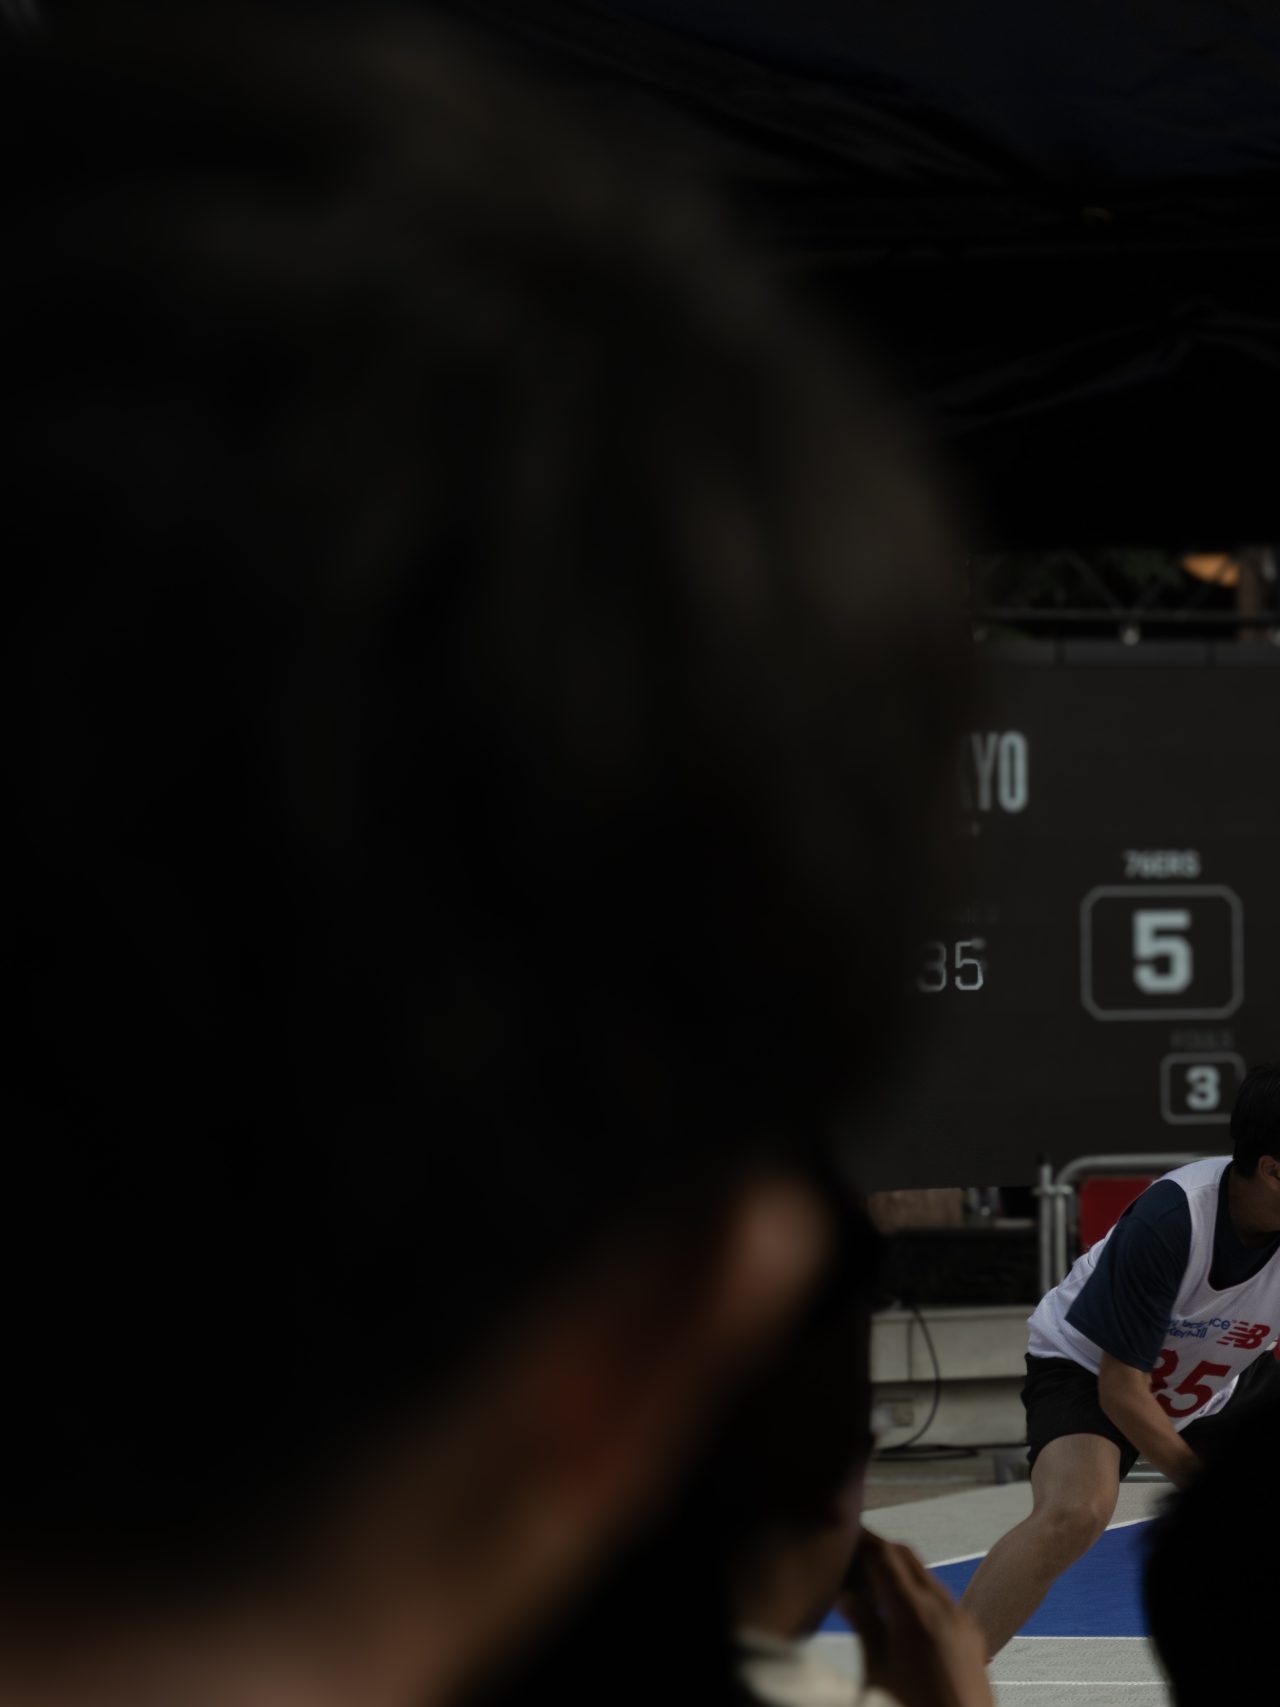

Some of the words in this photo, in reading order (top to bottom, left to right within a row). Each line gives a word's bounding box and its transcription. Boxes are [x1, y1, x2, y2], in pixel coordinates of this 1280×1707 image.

[968, 731, 1028, 813] YO
[1122, 849, 1202, 879] 76ERS
[1131, 907, 1194, 995] 5
[1185, 1066, 1221, 1111] 3
